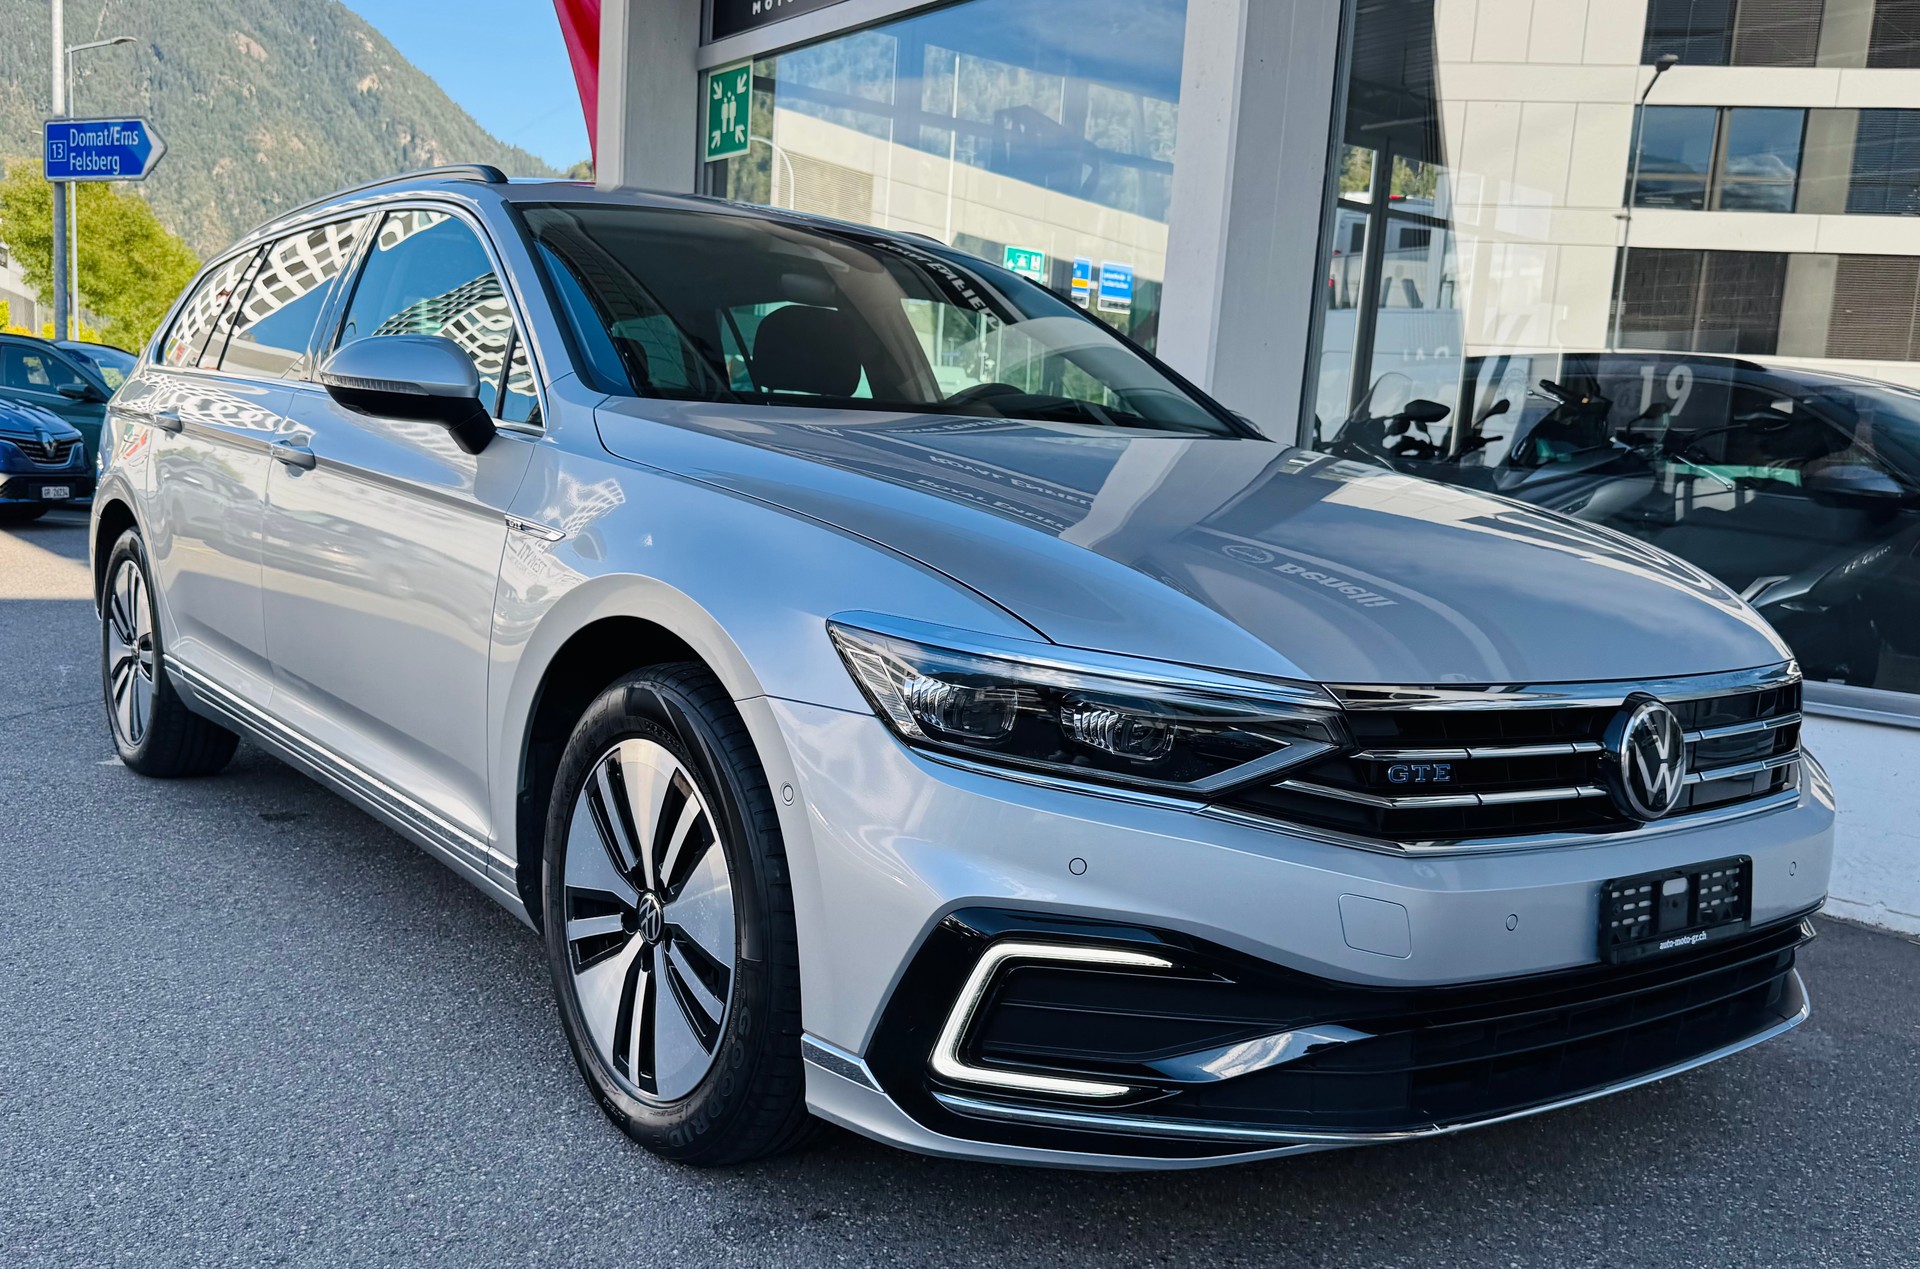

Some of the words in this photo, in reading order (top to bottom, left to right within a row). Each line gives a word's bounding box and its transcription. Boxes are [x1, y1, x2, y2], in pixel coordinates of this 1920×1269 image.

[69, 126, 139, 147] Domat/Ems
[51, 143, 64, 159] 13
[69, 151, 120, 175] Felsberg
[1388, 764, 1450, 783] GTE
[1659, 930, 1707, 950] auto-moto-gr.ch
